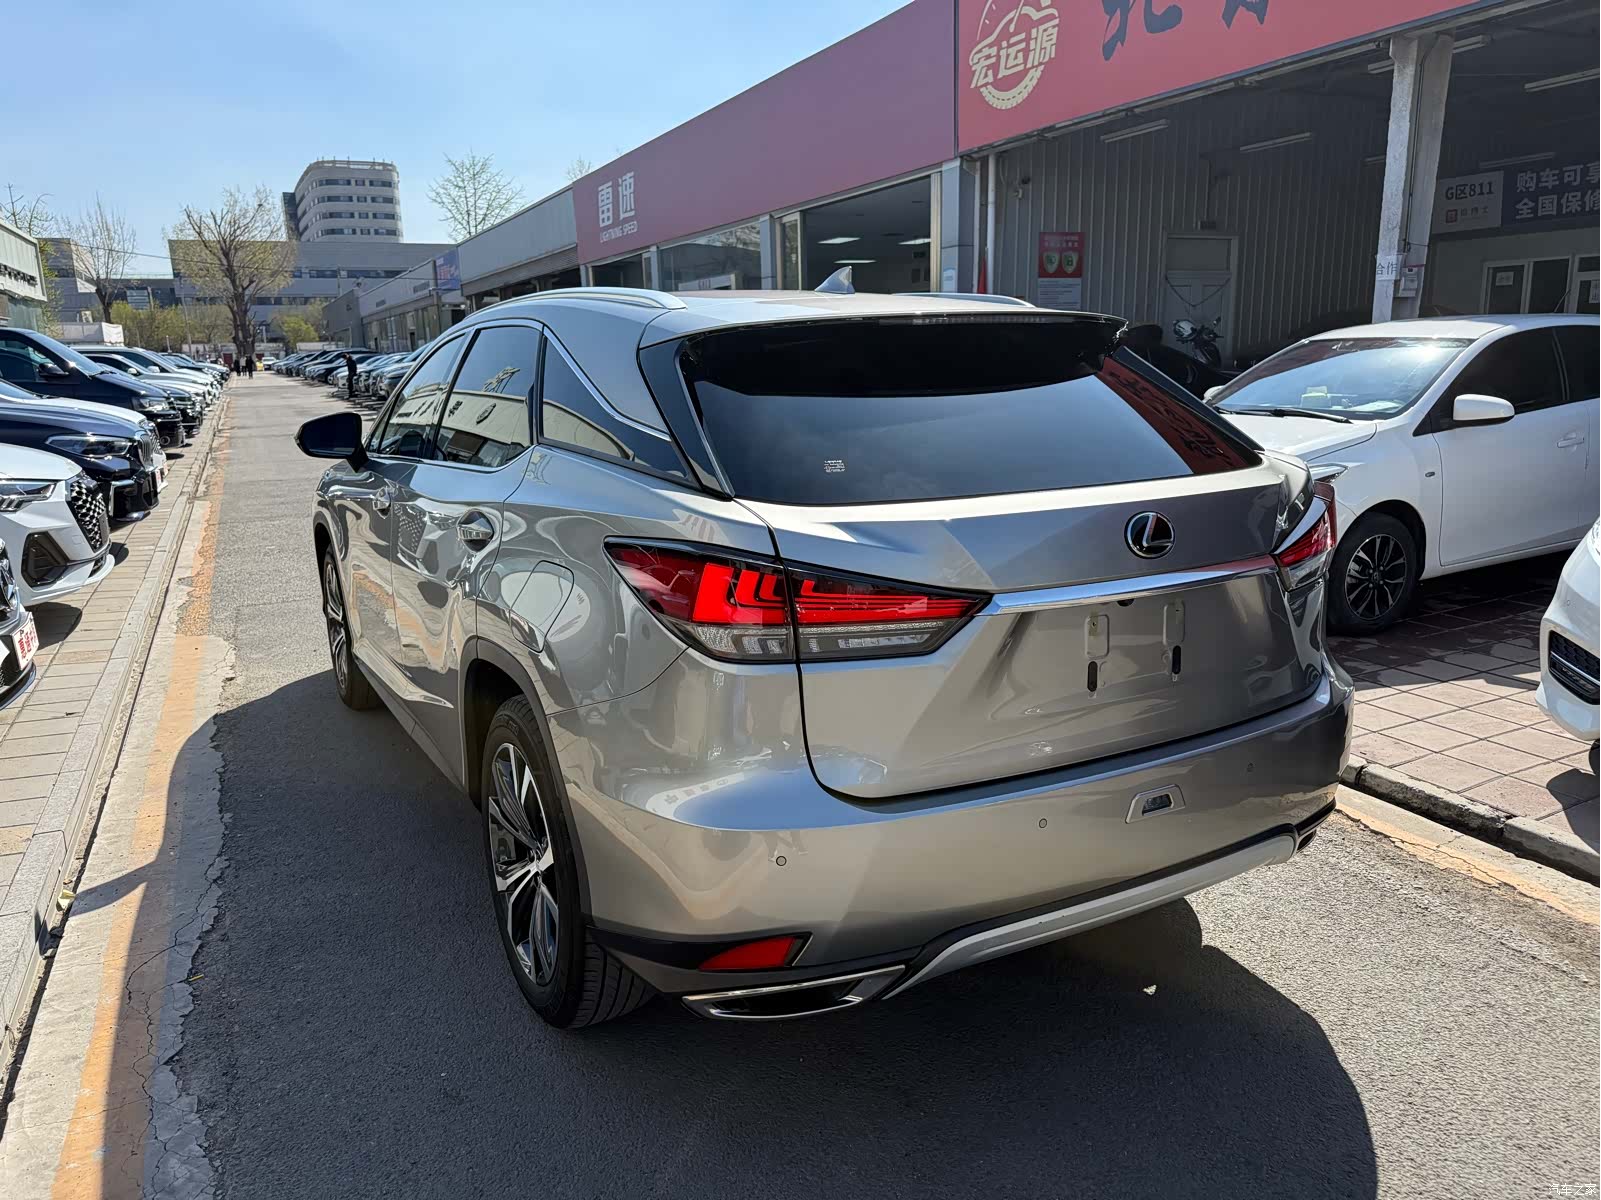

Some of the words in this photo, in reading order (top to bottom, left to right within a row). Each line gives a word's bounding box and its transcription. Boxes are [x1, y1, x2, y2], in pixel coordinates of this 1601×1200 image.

[970, 19, 1059, 88] 宏运源
[1445, 181, 1494, 200] G区811
[1516, 161, 1600, 193] 购车可享
[598, 171, 635, 228] 雷速
[1515, 188, 1600, 219] 全国保修
